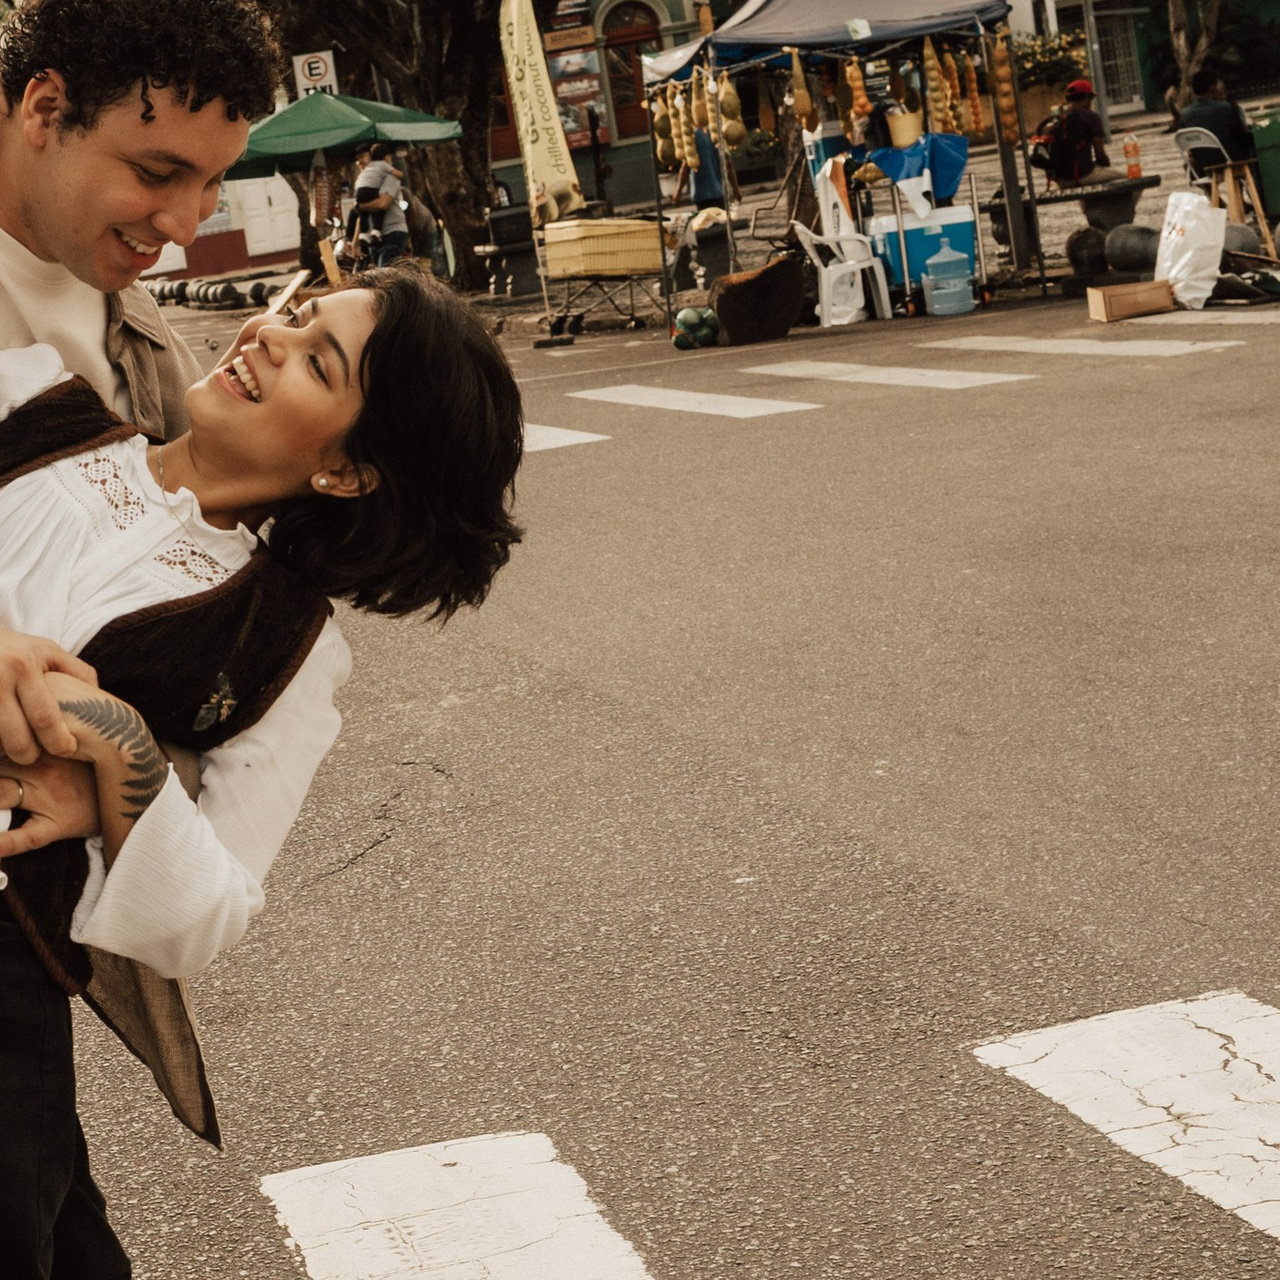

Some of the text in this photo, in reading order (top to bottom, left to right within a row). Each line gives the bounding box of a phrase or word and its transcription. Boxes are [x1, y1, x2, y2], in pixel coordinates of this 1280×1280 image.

[307, 60, 323, 77] E
[528, 62, 552, 122] coconut
[541, 126, 567, 175] chilled
